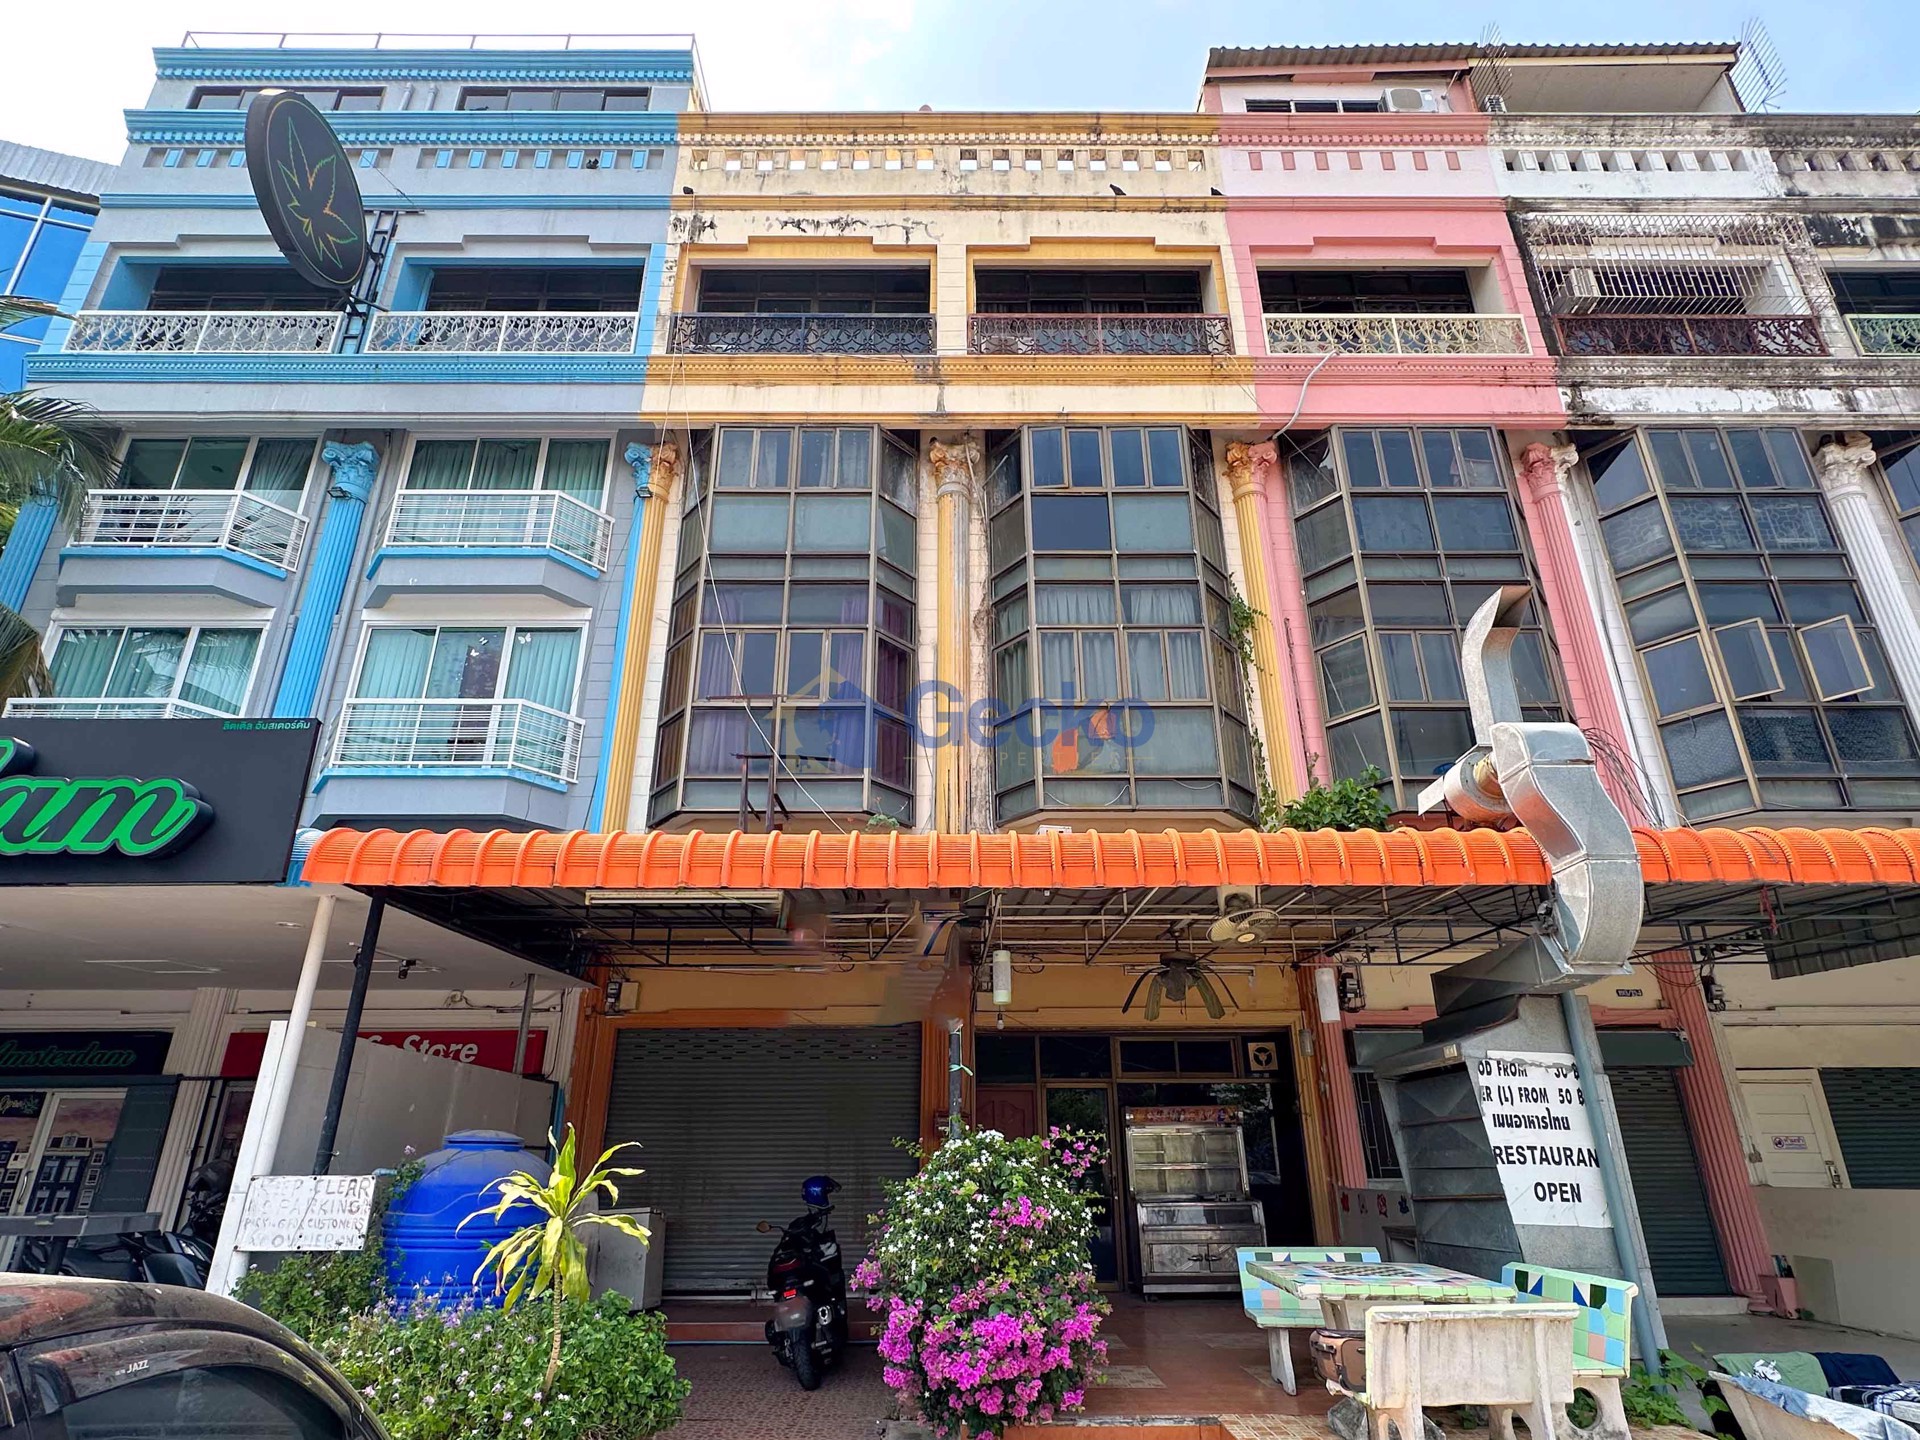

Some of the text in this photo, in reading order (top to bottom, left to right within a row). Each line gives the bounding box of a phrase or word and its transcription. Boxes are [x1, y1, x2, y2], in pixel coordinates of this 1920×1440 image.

[402, 1035, 478, 1063] Store
[1497, 1085, 1514, 1106] (L)
[1518, 1087, 1550, 1104] FROM
[1558, 1088, 1573, 1104] 50
[1492, 1145, 1600, 1168] RESTAURAN
[314, 1177, 371, 1199] CLEAR
[1533, 1182, 1582, 1203] OPEN
[126, 1359, 149, 1373] JAZZ
